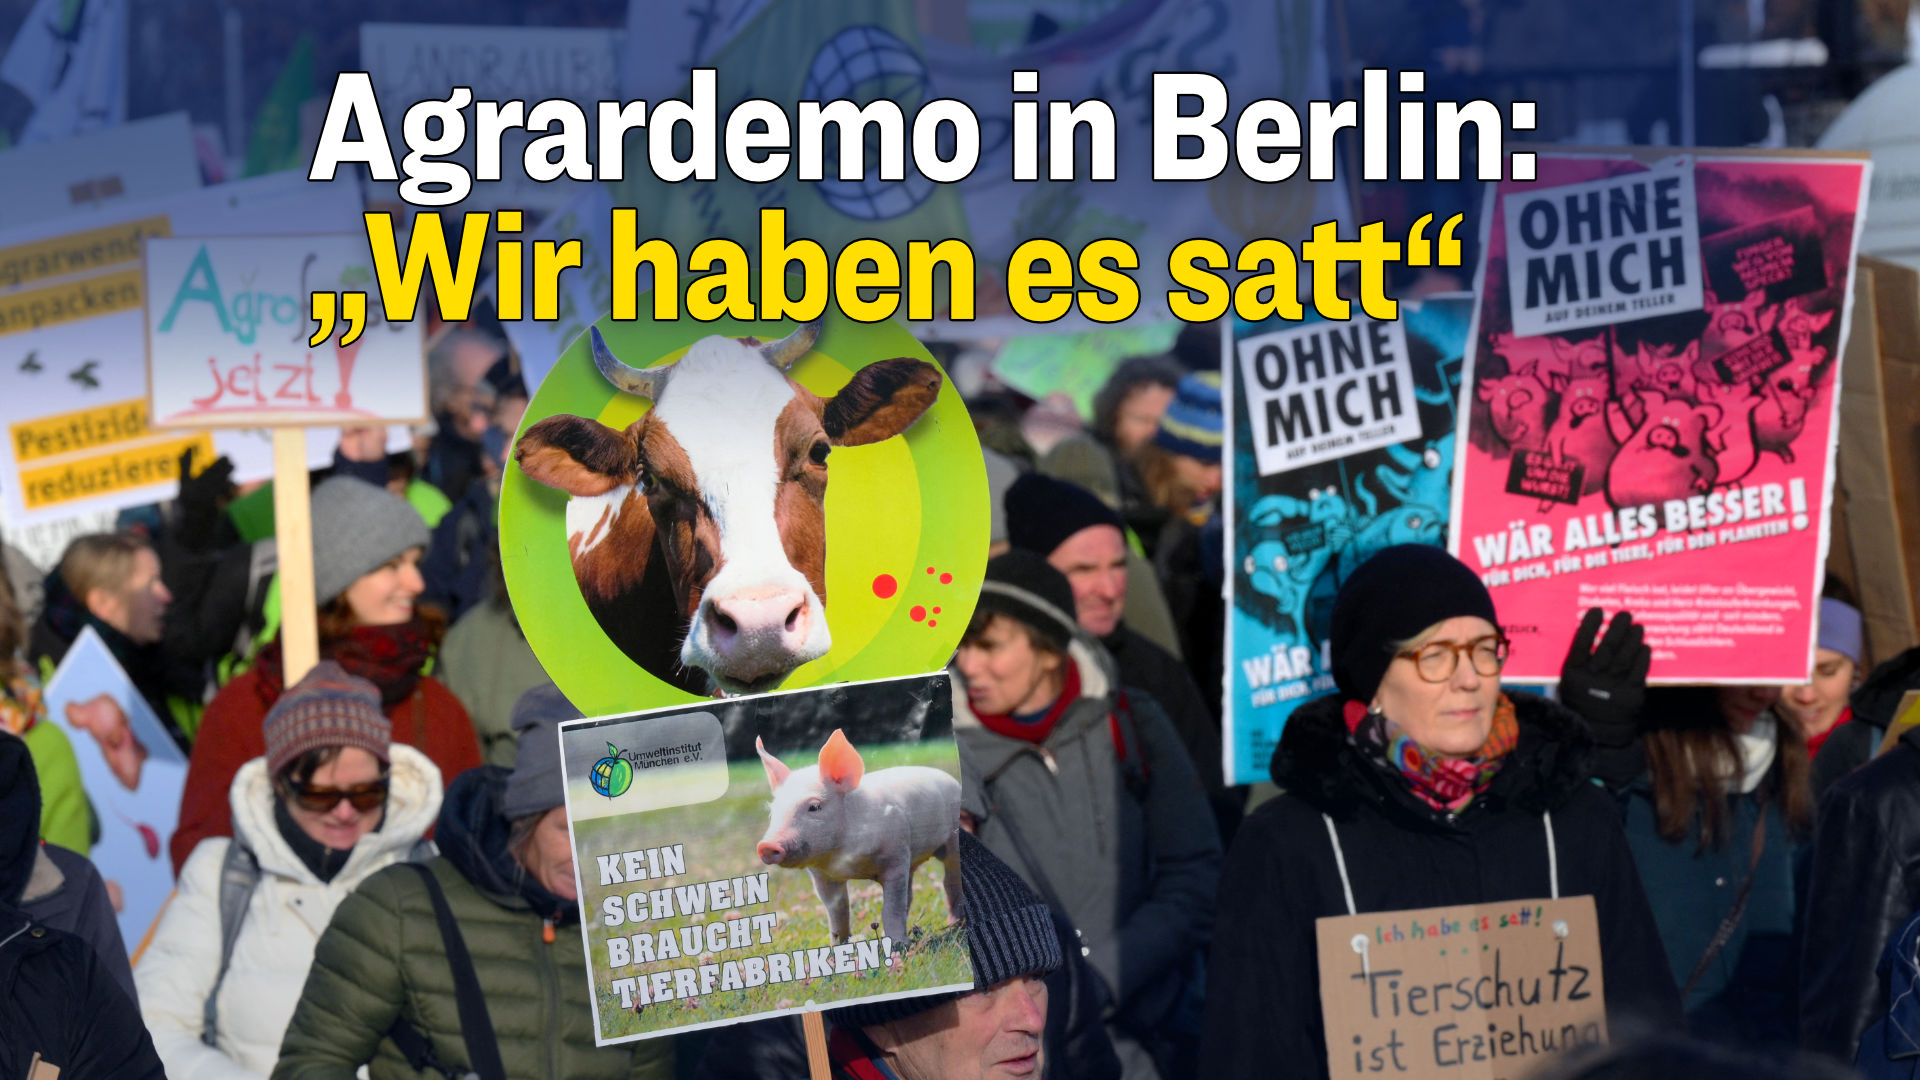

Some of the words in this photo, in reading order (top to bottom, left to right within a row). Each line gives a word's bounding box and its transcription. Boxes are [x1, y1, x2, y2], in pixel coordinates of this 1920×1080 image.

[1519, 176, 1682, 250] OHNE
[1525, 236, 1686, 310] MICH
[1546, 310, 1569, 323] AUF
[1575, 302, 1627, 319] DEINEM
[1632, 294, 1675, 310] TELLER
[1255, 320, 1394, 391] OHNE
[16, 405, 149, 457] Pestizid
[1266, 370, 1402, 448] MICH
[1473, 520, 1555, 569] WÄR
[1564, 504, 1659, 553] ALLES
[1664, 478, 1810, 533] BESSER!
[1482, 567, 1510, 588] FÜR
[1513, 562, 1551, 583] DICH,
[1554, 553, 1582, 574] FÜR
[1585, 551, 1608, 569] DIE
[1611, 543, 1654, 564] TIERE,
[1657, 538, 1684, 557] FÜR
[1688, 532, 1716, 550] DEN
[1719, 518, 1789, 545] PLANETEN
[1242, 642, 1314, 691] WÄR
[628, 742, 702, 761] Umweltinstitut
[634, 756, 680, 770] München
[683, 752, 703, 763] e.V.
[596, 843, 686, 886] KEIN
[602, 872, 769, 928] SCHWEIN
[1375, 925, 1405, 945] Ich
[1411, 917, 1461, 941] habe
[1469, 915, 1489, 932] es
[1498, 906, 1543, 928] satt!
[606, 912, 778, 969] BRAUCHT
[611, 936, 893, 1009] TIERFABRIKEN!
[1350, 941, 1592, 1018] Tierschutz
[1352, 1029, 1407, 1073] ist
